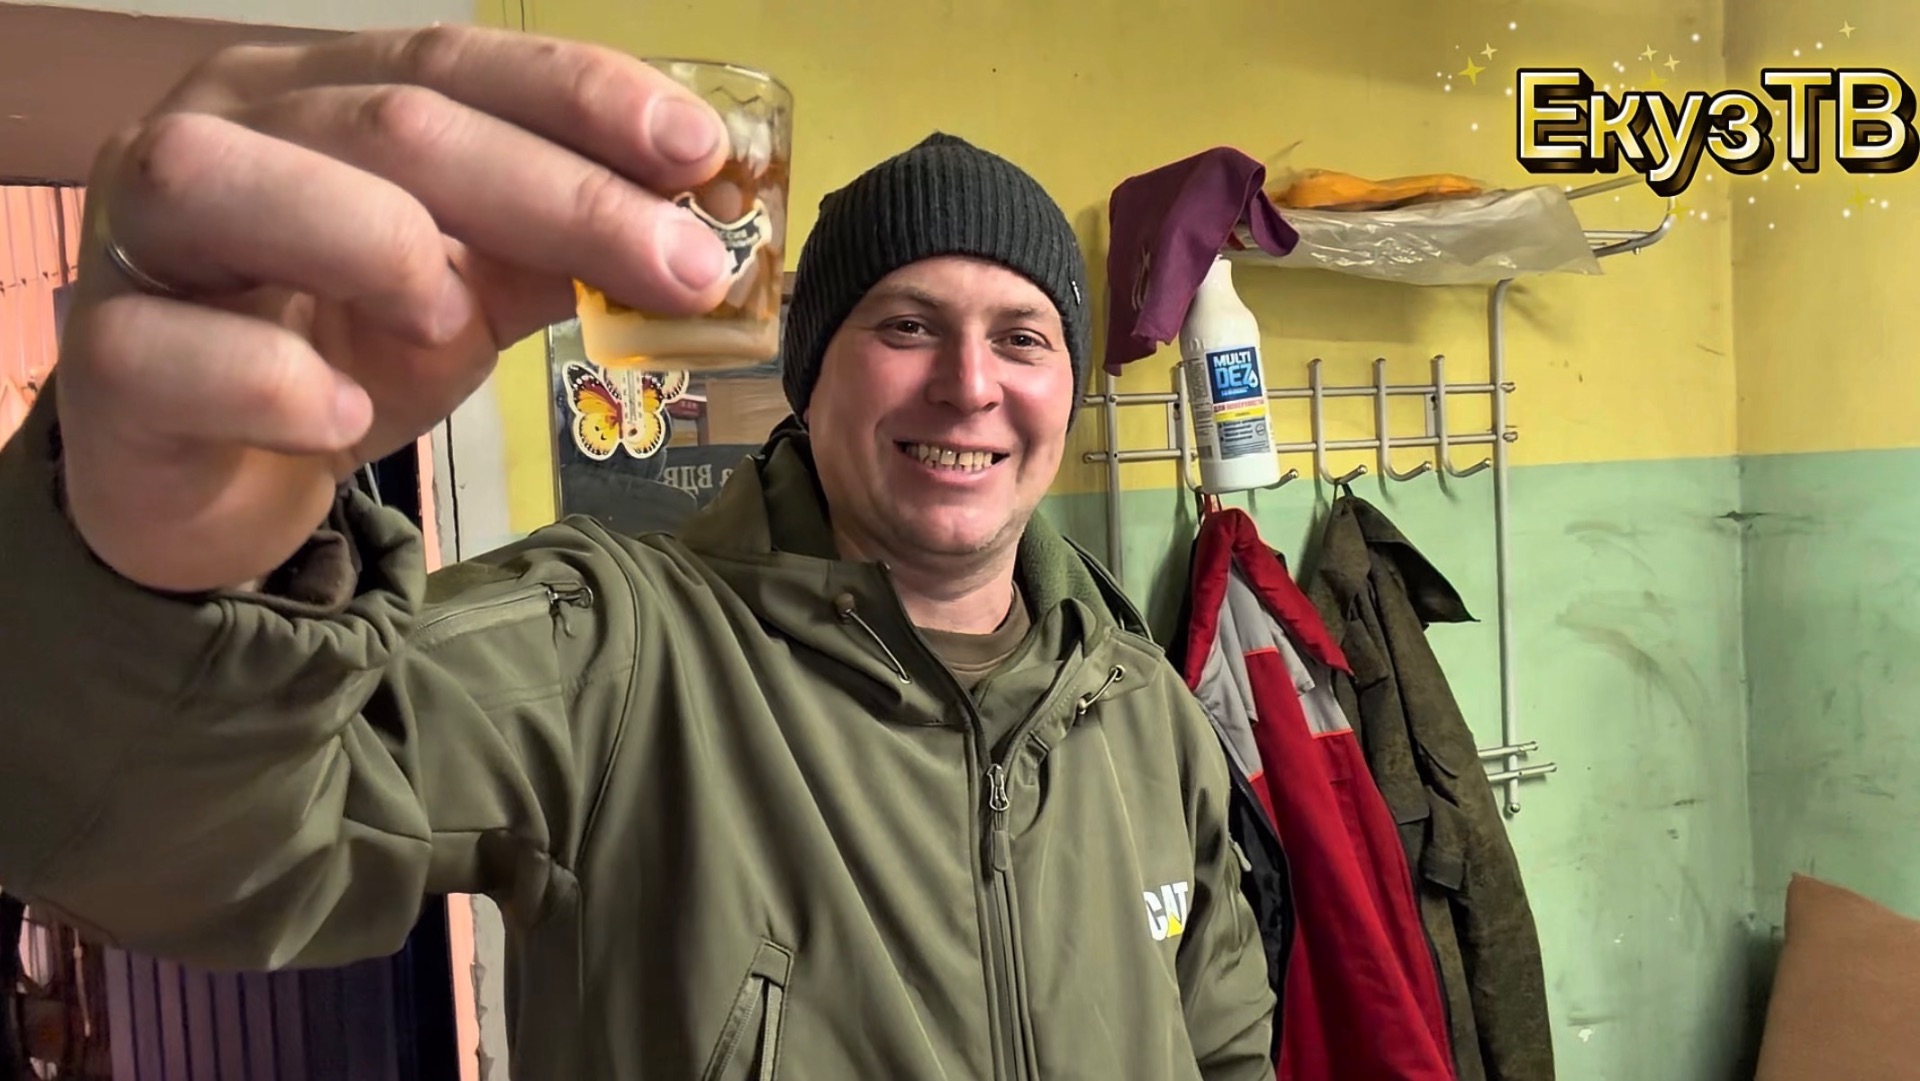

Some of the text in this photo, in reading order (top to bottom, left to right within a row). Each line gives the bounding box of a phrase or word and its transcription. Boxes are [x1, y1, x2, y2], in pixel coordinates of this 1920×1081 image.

[1213, 351, 1251, 368] MULTI
[1214, 363, 1252, 389] DEZ
[1142, 881, 1189, 941] CAT
